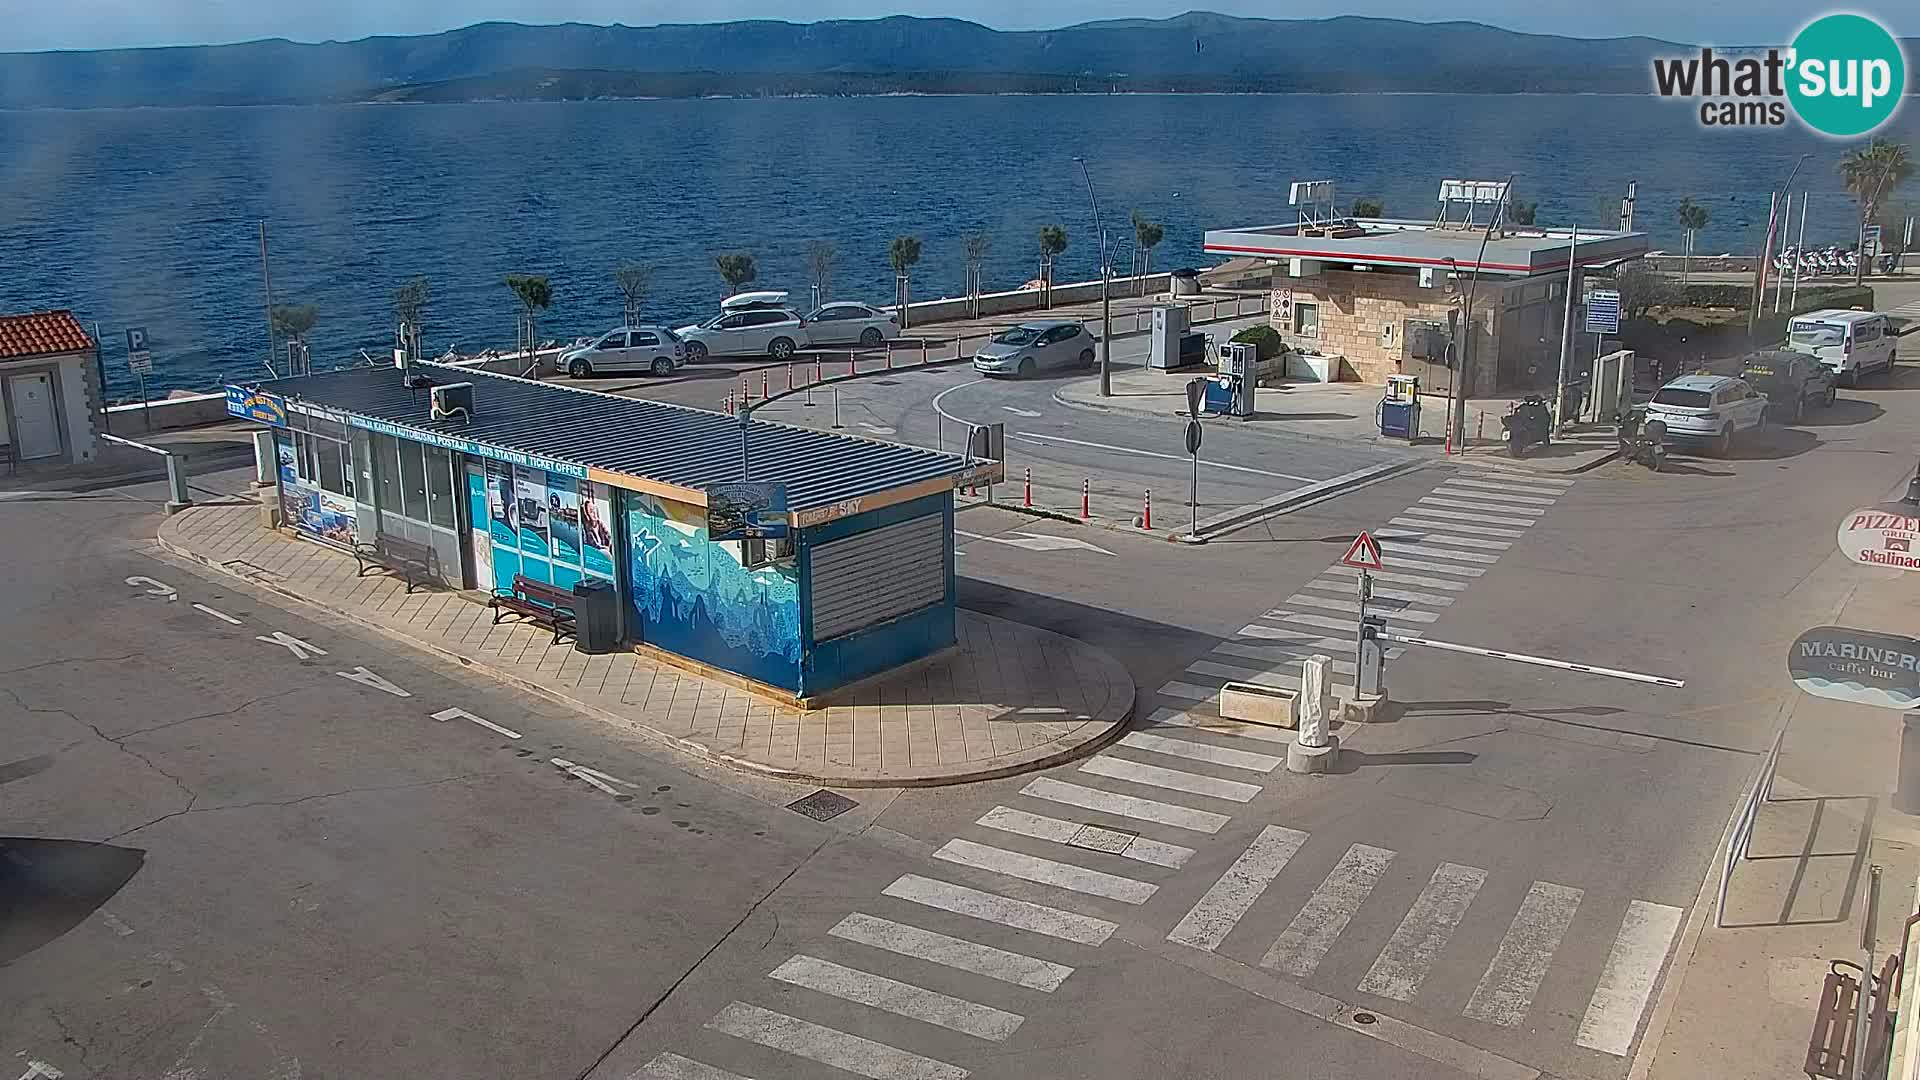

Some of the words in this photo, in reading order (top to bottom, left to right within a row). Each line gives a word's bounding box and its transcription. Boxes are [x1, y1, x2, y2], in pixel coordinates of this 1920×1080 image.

[131, 331, 143, 348] P
[373, 421, 396, 434] KARATA
[397, 427, 437, 444] AUTOBUSNA
[437, 436, 468, 450] POSTAJA
[478, 445, 493, 456] BUS
[495, 449, 527, 464] STATION
[529, 456, 554, 471] TICKET
[556, 463, 583, 476] OFFICE
[1848, 515, 1920, 532] PIZZE
[1882, 529, 1917, 540] GRILL
[1829, 662, 1865, 674] caffe
[1870, 665, 1896, 679] bar
